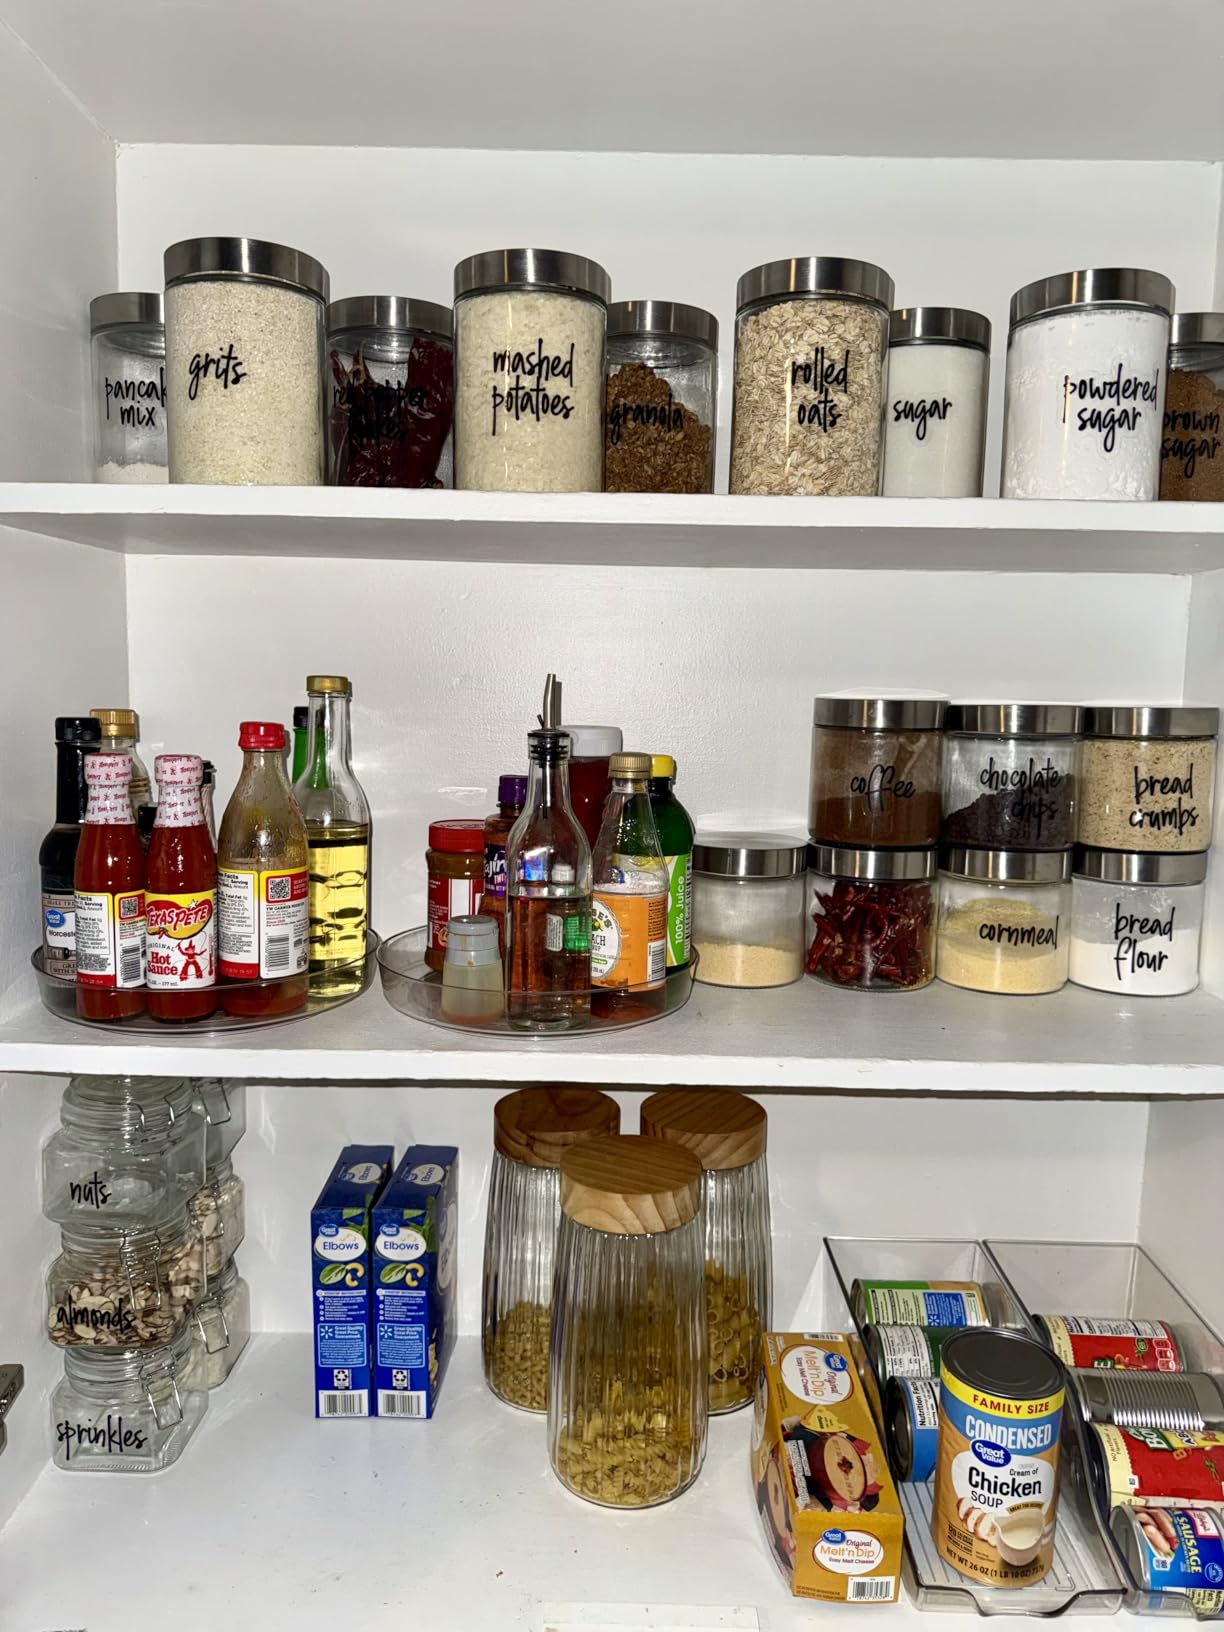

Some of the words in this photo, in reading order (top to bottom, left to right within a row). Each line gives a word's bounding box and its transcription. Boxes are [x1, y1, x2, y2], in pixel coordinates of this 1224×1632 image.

[188, 344, 247, 401] grits
[492, 339, 576, 388] mashed
[791, 347, 850, 395] rolled
[105, 367, 167, 421] pancak
[492, 375, 576, 437] potatoes
[1062, 363, 1160, 424] powdered
[120, 401, 156, 428] mix
[609, 392, 684, 446] granola
[797, 391, 843, 434] oats
[893, 397, 953, 441] sugar
[1077, 403, 1143, 453] sugar
[850, 764, 916, 815] coffee
[979, 757, 1061, 790] chocolate
[1134, 763, 1194, 800] bread
[1011, 788, 1059, 838] chips
[1130, 797, 1199, 835] crumbs
[676, 875, 685, 909] Juice
[147, 906, 177, 928] TEXAS
[173, 905, 210, 931] PETE
[674, 911, 685, 944] 100%
[979, 915, 1060, 951] cornmeal
[1114, 903, 1176, 942] bread
[147, 960, 178, 976] Sauce
[151, 952, 171, 965] Hot
[1114, 939, 1169, 981] flour
[70, 1171, 112, 1209] nuts
[323, 1241, 359, 1251] Elbows
[383, 1241, 420, 1251] Elbows
[57, 1298, 135, 1334] almonds
[801, 1378, 811, 1396] Cheese
[811, 1380, 825, 1397] Dip
[824, 1371, 843, 1395] Original
[915, 1395, 926, 1426] Nutrition
[973, 1394, 1022, 1414] FAMILY
[1028, 1402, 1050, 1414] SIZE
[57, 1415, 148, 1460] sprinkles
[965, 1414, 1052, 1450] CONDENSED
[975, 1442, 1005, 1459] Great
[981, 1452, 1005, 1464] Value
[968, 1466, 1042, 1498] Chicken
[1009, 1468, 1031, 1476] Cream
[1031, 1467, 1039, 1475] of
[970, 1490, 1003, 1508] SOUP
[846, 1539, 873, 1550] Original
[856, 1548, 875, 1559] Dip
[946, 1545, 957, 1559] NET
[957, 1553, 968, 1566] WT
[969, 1561, 979, 1571] 26
[979, 1567, 989, 1576] OZ
[990, 1569, 997, 1577] (1
[999, 1570, 1008, 1578] LB
[1011, 1570, 1019, 1578] 10
[1176, 1516, 1202, 1574] SAUSAGE
